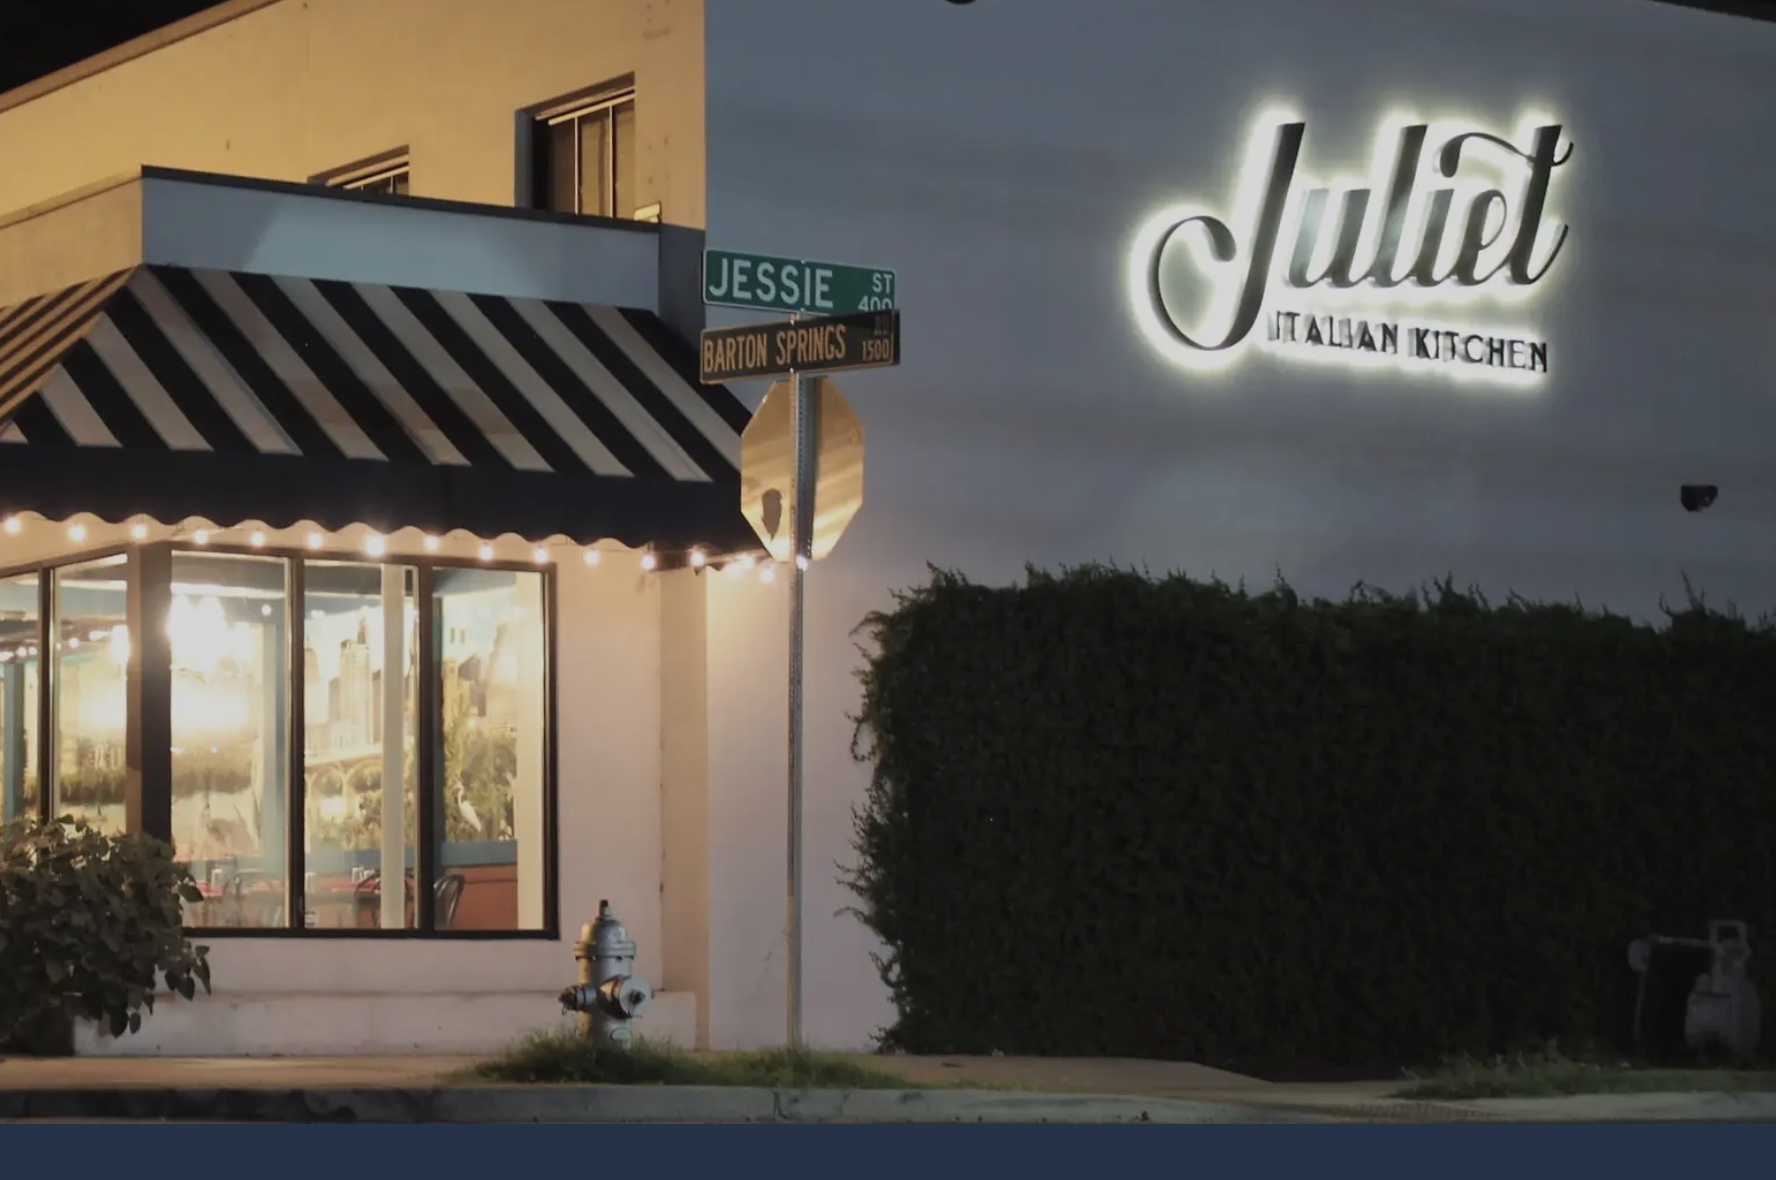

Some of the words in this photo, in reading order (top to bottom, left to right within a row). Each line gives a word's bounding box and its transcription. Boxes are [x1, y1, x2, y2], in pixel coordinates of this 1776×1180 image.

[1148, 122, 1574, 351] Juliet
[708, 257, 833, 308] JESSIE
[872, 273, 892, 293] ST
[858, 295, 892, 312] 400
[704, 333, 768, 373] BARTON
[776, 324, 846, 366] SPRINGS
[862, 339, 890, 361] 1500
[1270, 311, 1398, 354] ITALIAN
[1409, 327, 1547, 373] KITCHEN
